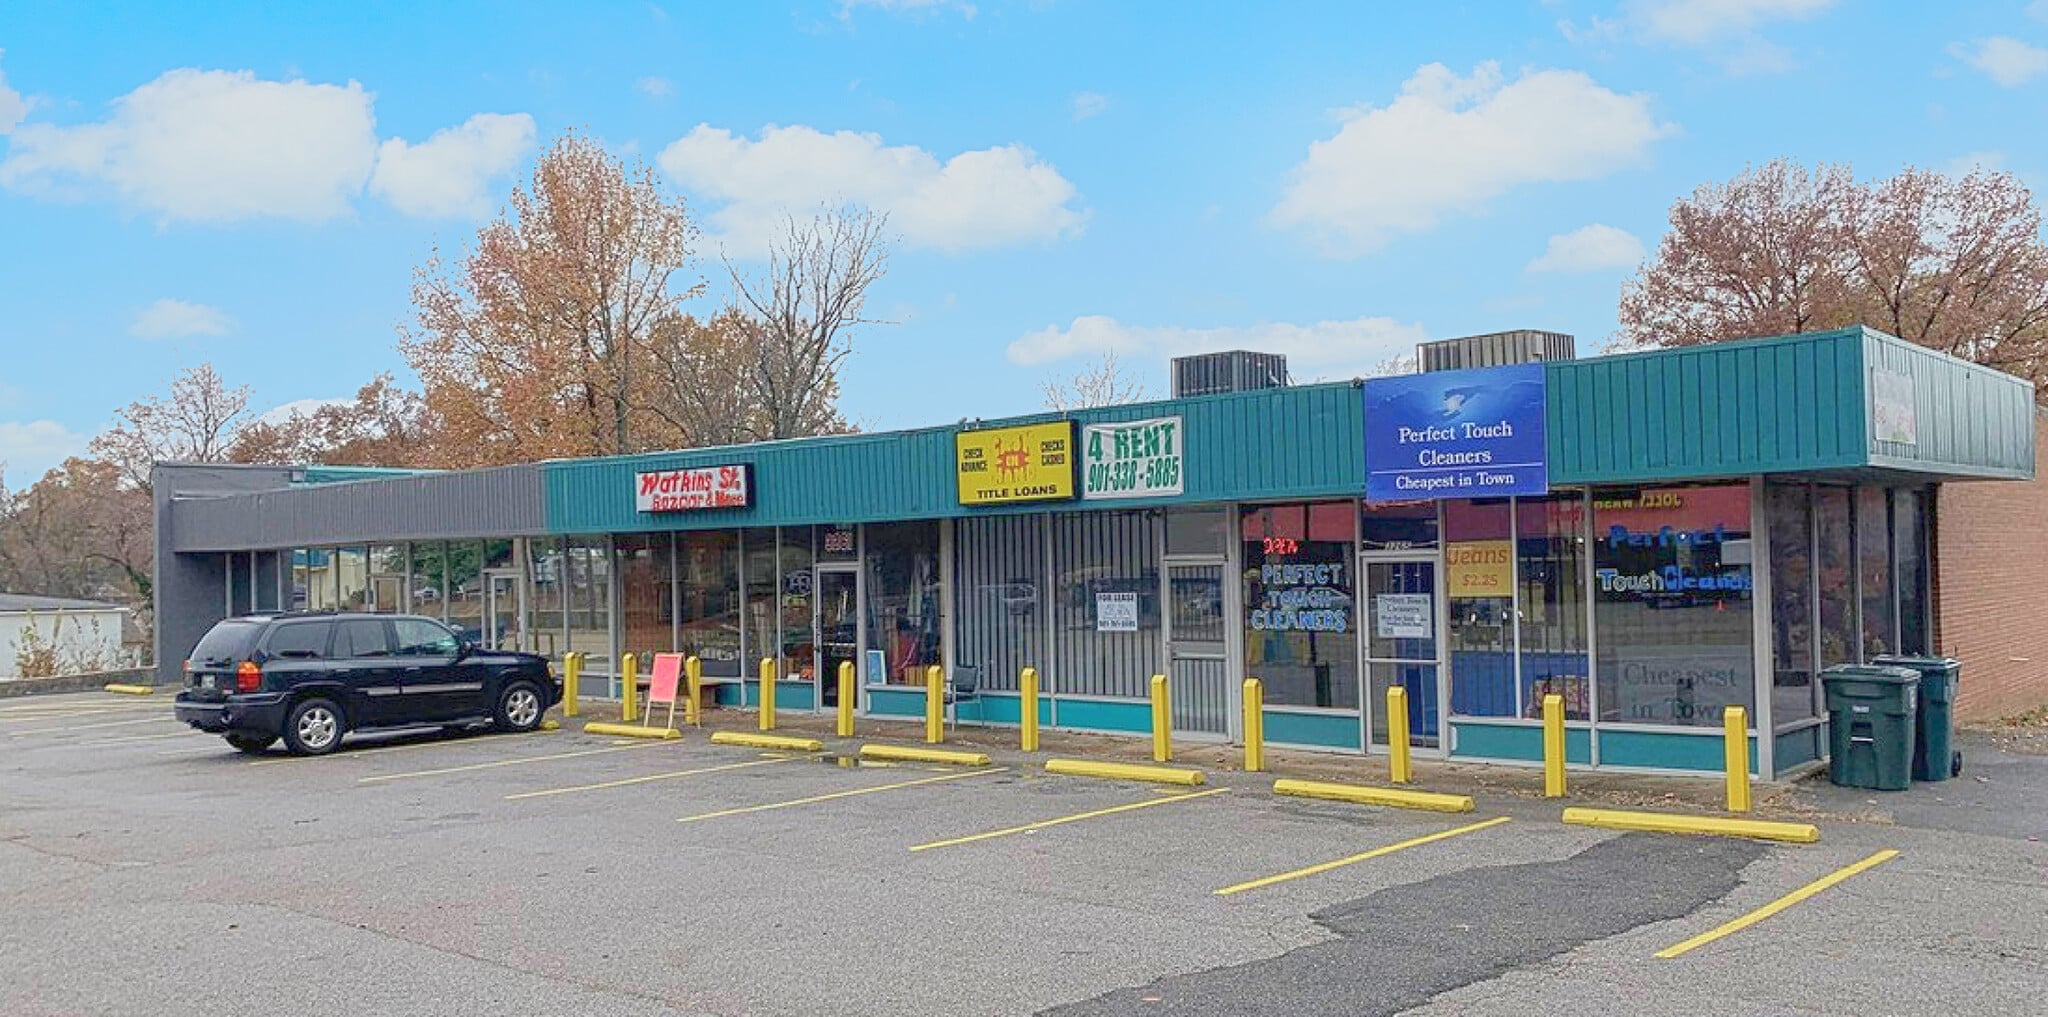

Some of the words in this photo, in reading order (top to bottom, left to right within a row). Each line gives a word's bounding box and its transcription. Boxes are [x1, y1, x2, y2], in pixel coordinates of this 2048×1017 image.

[1089, 431, 1103, 462] 4
[1114, 423, 1175, 459] RENT
[1398, 426, 1456, 444] Perfect
[1462, 421, 1512, 439] Touch
[1418, 449, 1492, 467] Cleaners
[641, 469, 713, 495] Watkins
[976, 487, 1009, 499] TITLE
[1015, 484, 1058, 497] LOANS
[1396, 475, 1455, 491] Cheapest
[1459, 472, 1472, 486] in
[1476, 471, 1515, 486] Town
[1447, 549, 1508, 565] Jeans
[1261, 563, 1343, 585] PERFECT
[1596, 567, 1664, 592] Touch
[1268, 590, 1331, 608] TOUCH
[1251, 609, 1347, 632] CLEANERS
[1623, 663, 1738, 690] Cheapest
[1664, 697, 1726, 720] Tow
